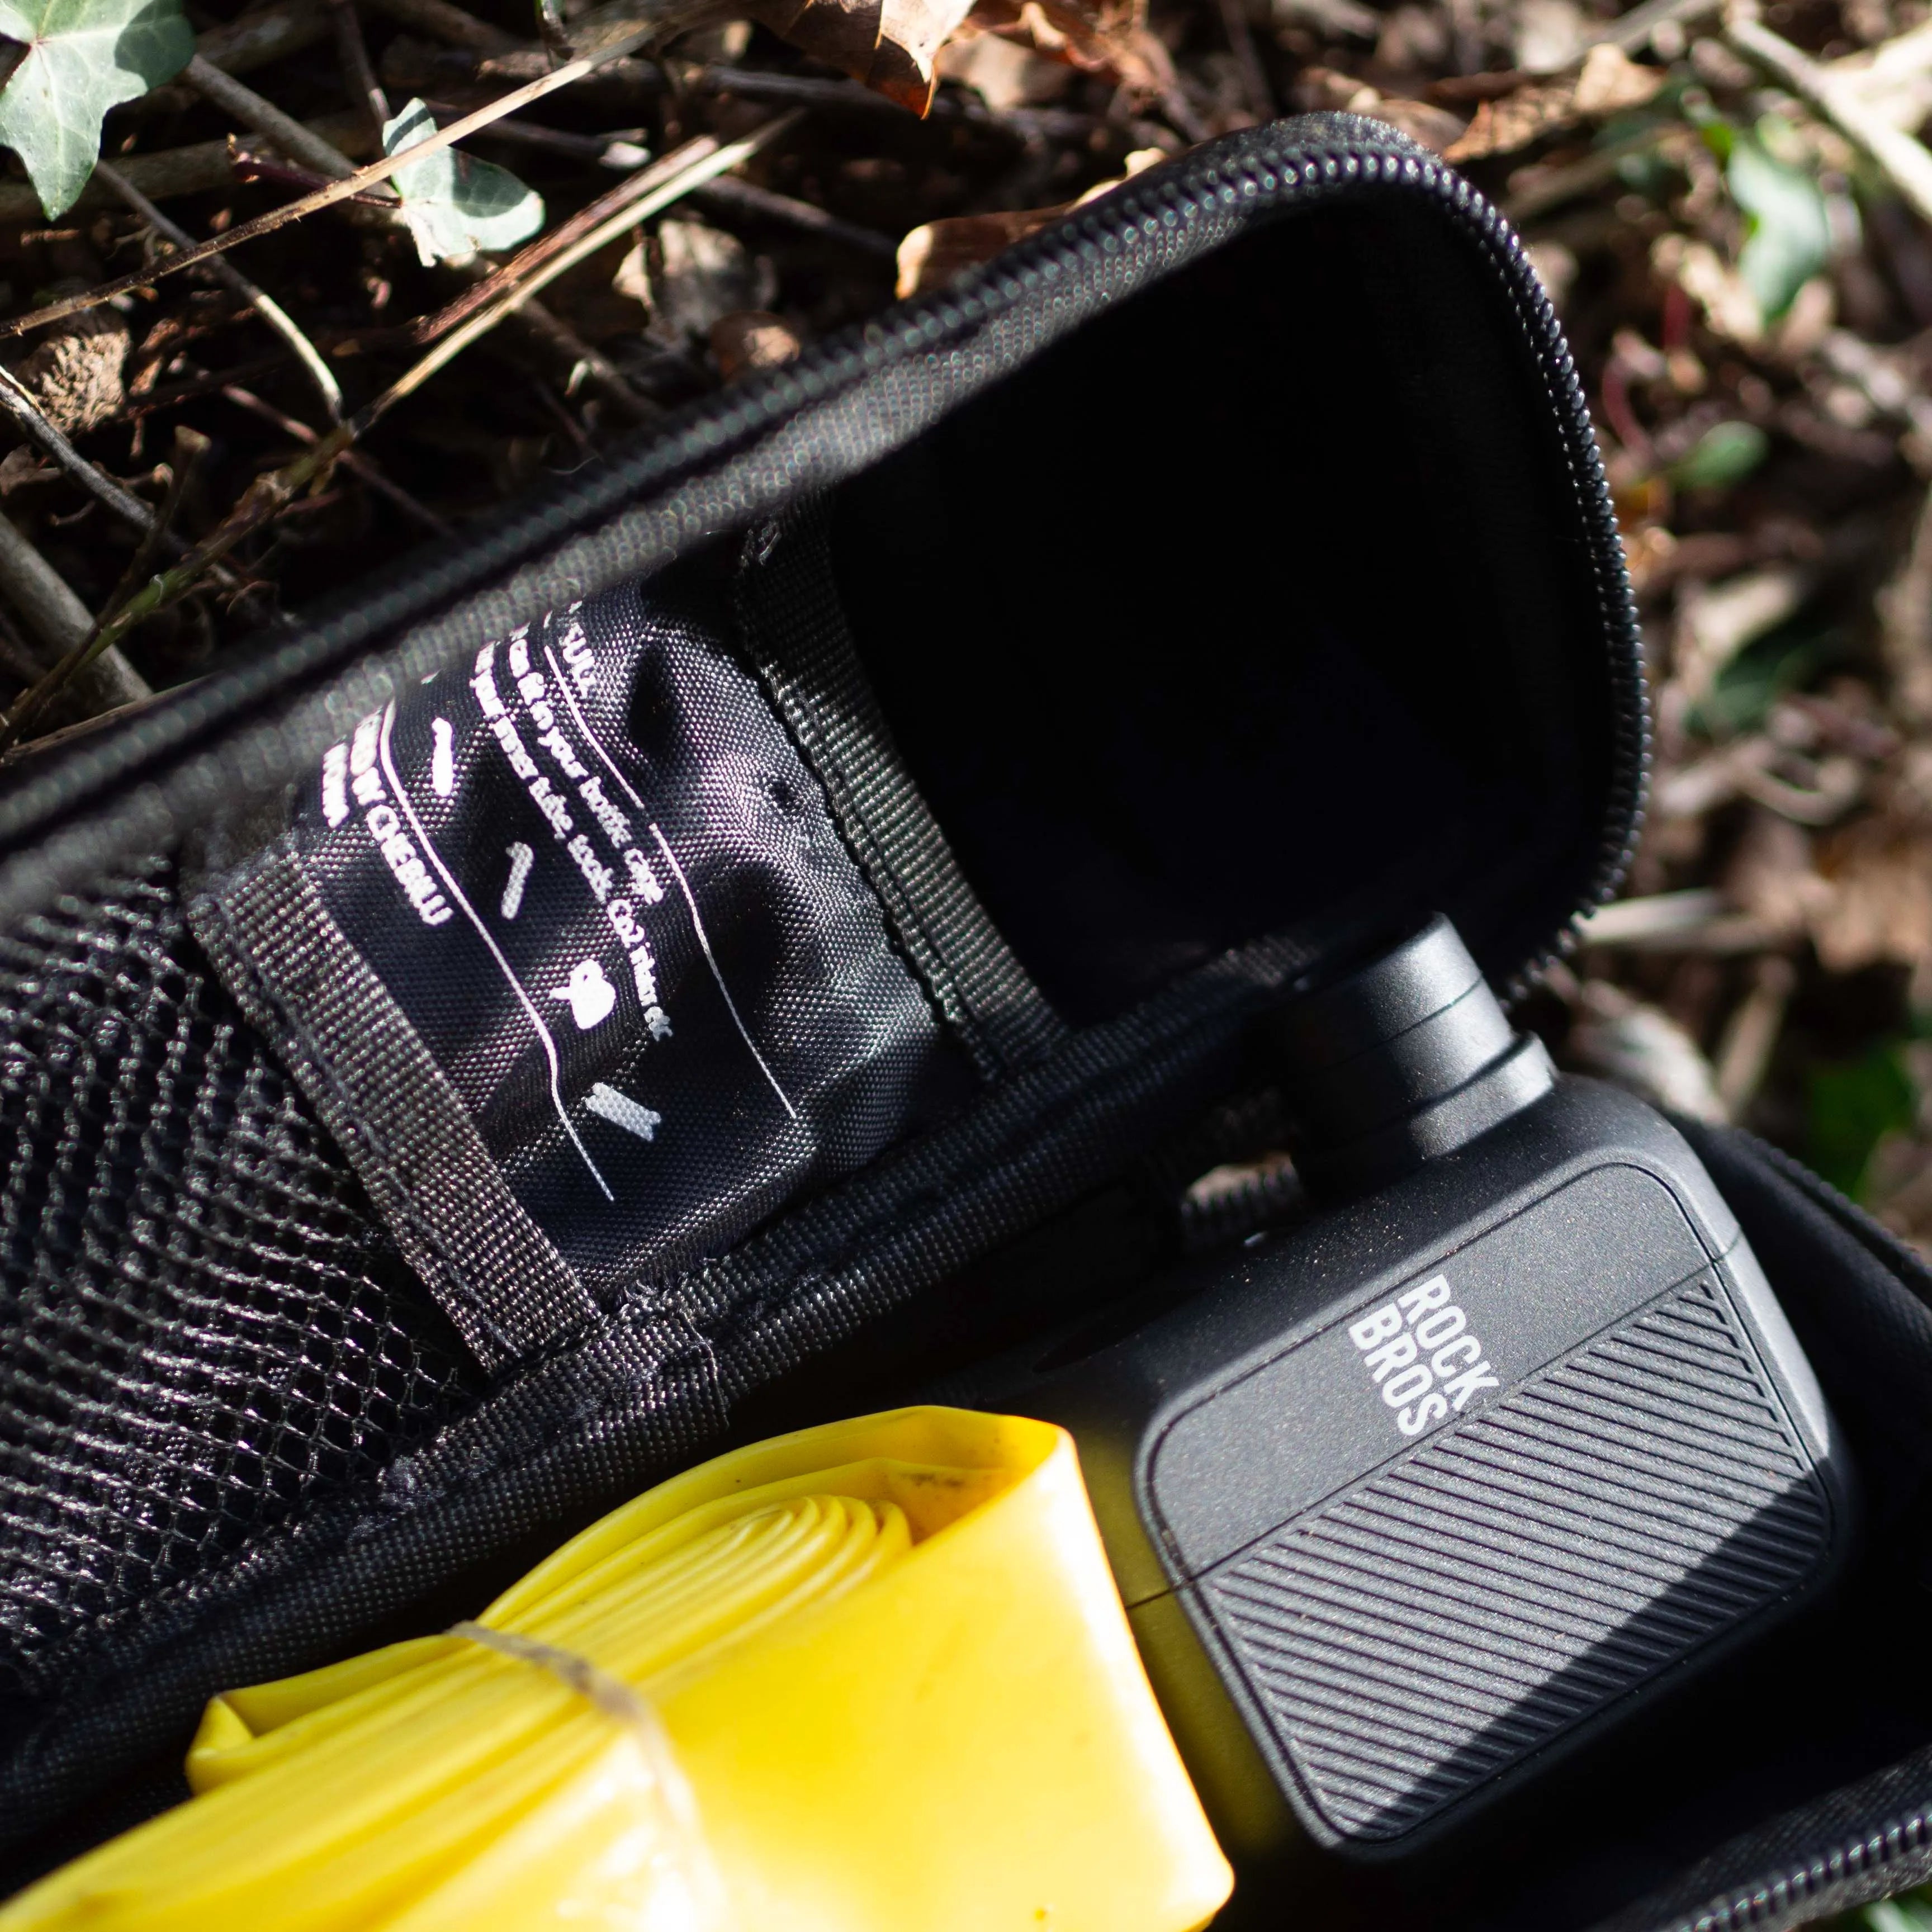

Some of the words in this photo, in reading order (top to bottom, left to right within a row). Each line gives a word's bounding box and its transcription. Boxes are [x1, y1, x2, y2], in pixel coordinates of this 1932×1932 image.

[534, 726, 589, 778] your
[578, 776, 632, 849] bottle
[623, 848, 664, 905] cage
[1348, 1303, 1448, 1436] BROS
[1397, 1273, 1500, 1412] ROCK
